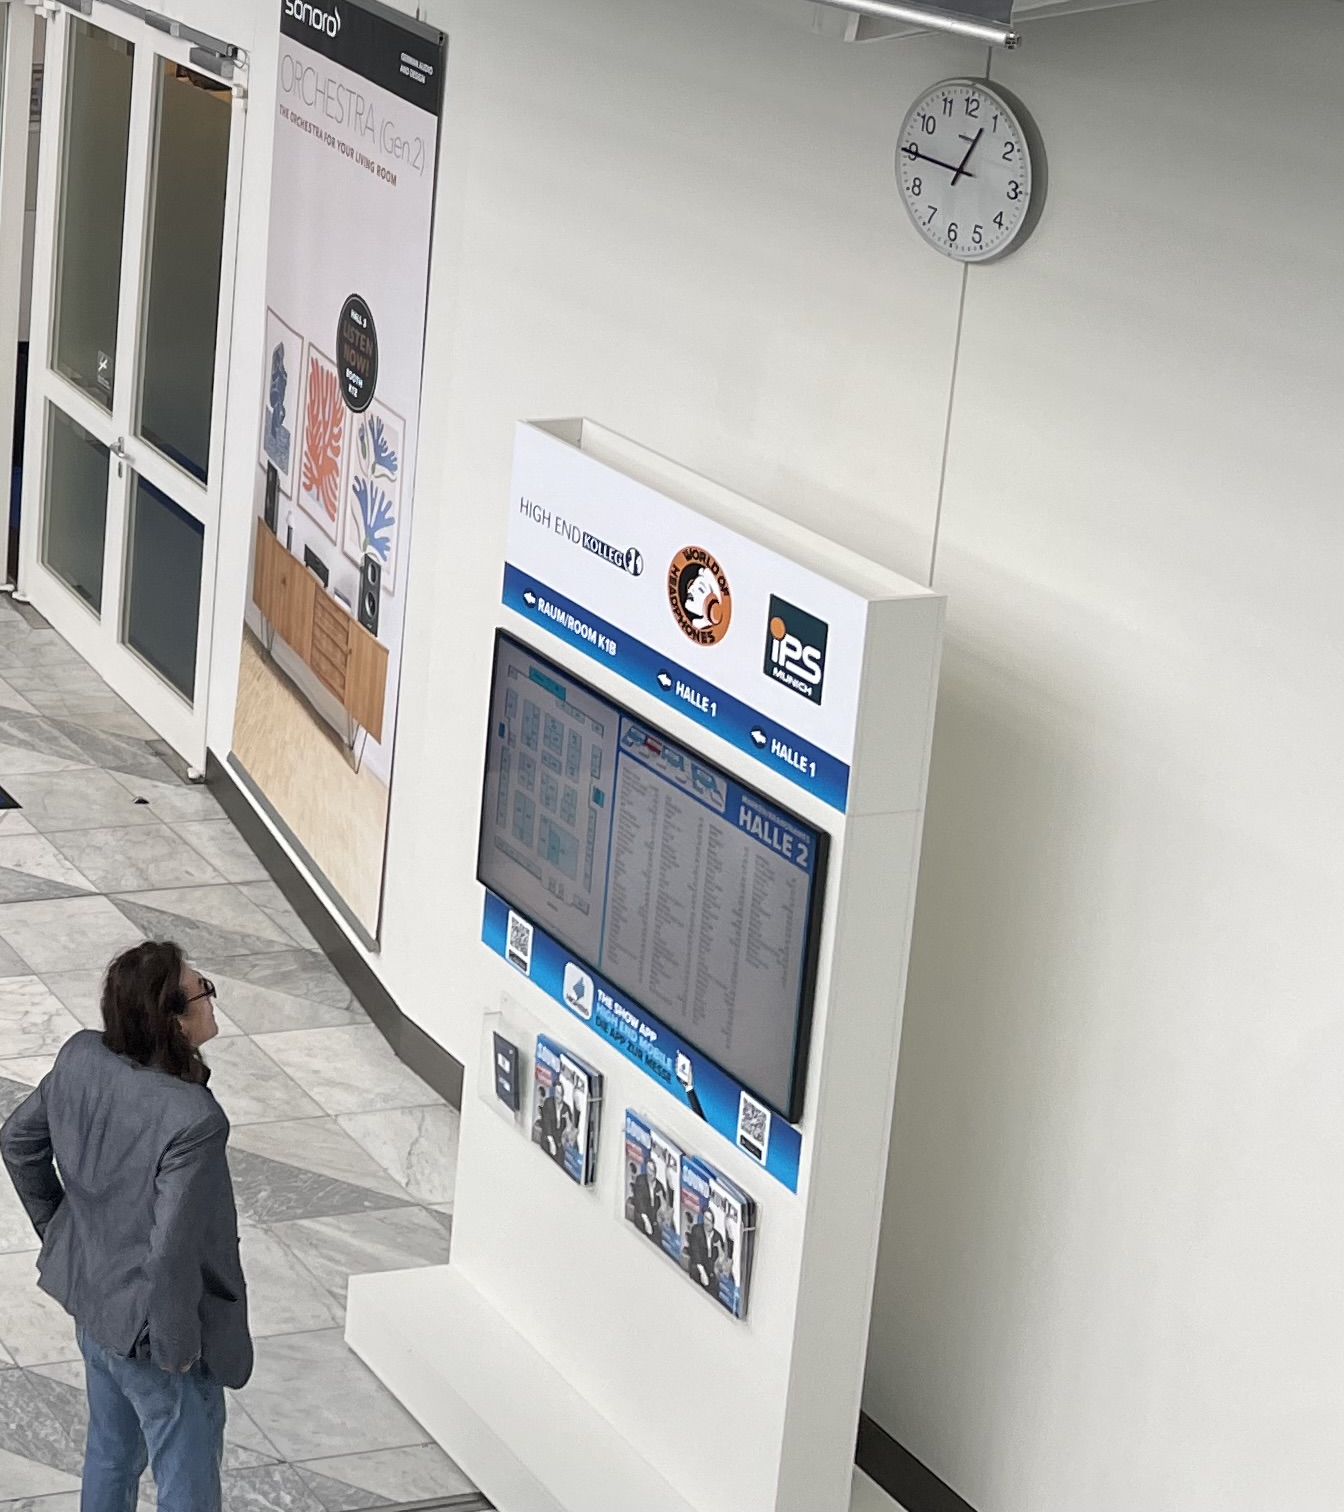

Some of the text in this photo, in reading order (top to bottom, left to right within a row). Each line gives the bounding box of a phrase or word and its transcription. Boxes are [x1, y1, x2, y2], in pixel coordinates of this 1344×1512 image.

[281, 54, 375, 144] ORCHESTRA
[942, 97, 954, 118] 11
[964, 96, 980, 119] 12
[920, 114, 936, 135] 10
[992, 114, 999, 133] 1
[279, 104, 397, 187] THE ORCHESTRA FOR YOUR LIVING ROOM
[1002, 141, 1015, 162] 2
[911, 177, 922, 197] 8
[1006, 180, 1020, 201] 3
[927, 205, 938, 224] 7
[993, 211, 1004, 230] 4
[947, 222, 958, 242] 6
[971, 224, 983, 244] 5
[343, 320, 373, 357] LISTEN
[343, 343, 370, 377] NOW!
[520, 496, 624, 567] HIGH END KOLLEG
[682, 548, 730, 596] WORLD OF
[668, 564, 716, 644] HEADPHONES
[537, 597, 617, 656] RAUM/ROOM K1B
[772, 666, 813, 696] MUNICH
[675, 680, 717, 718] HALLE 1
[771, 738, 816, 778] HALLE 1
[739, 805, 792, 858] HALLE
[796, 843, 809, 868] 2
[597, 989, 613, 1010] THE
[614, 1002, 639, 1029] SHOW
[639, 1021, 658, 1042] APP
